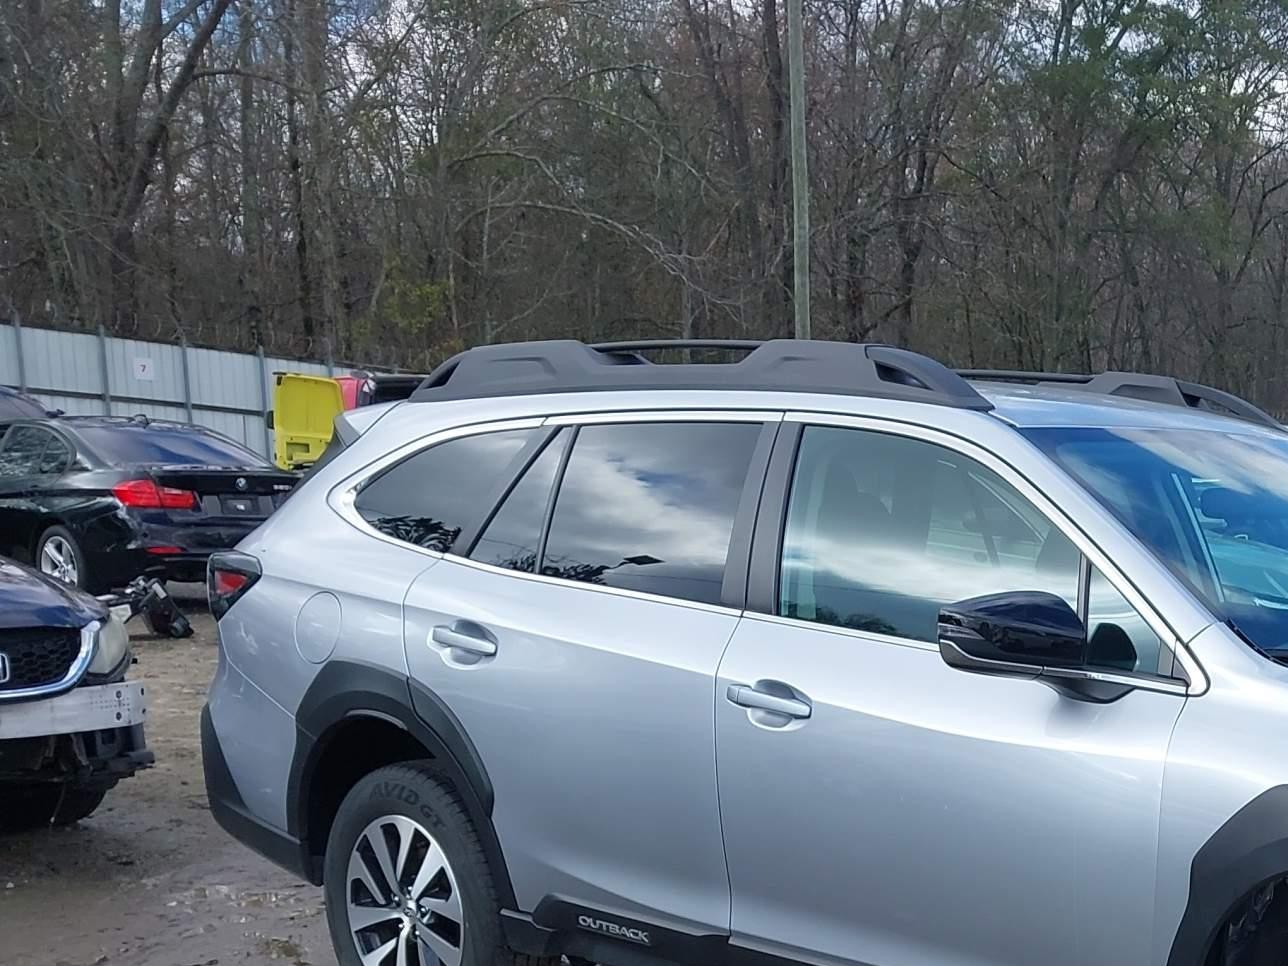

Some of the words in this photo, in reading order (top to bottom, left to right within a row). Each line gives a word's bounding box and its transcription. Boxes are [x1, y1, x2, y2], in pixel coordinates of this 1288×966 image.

[139, 364, 146, 372] 7
[369, 781, 420, 805] AVID
[420, 804, 447, 829] GT
[578, 915, 649, 943] OUTBACK
